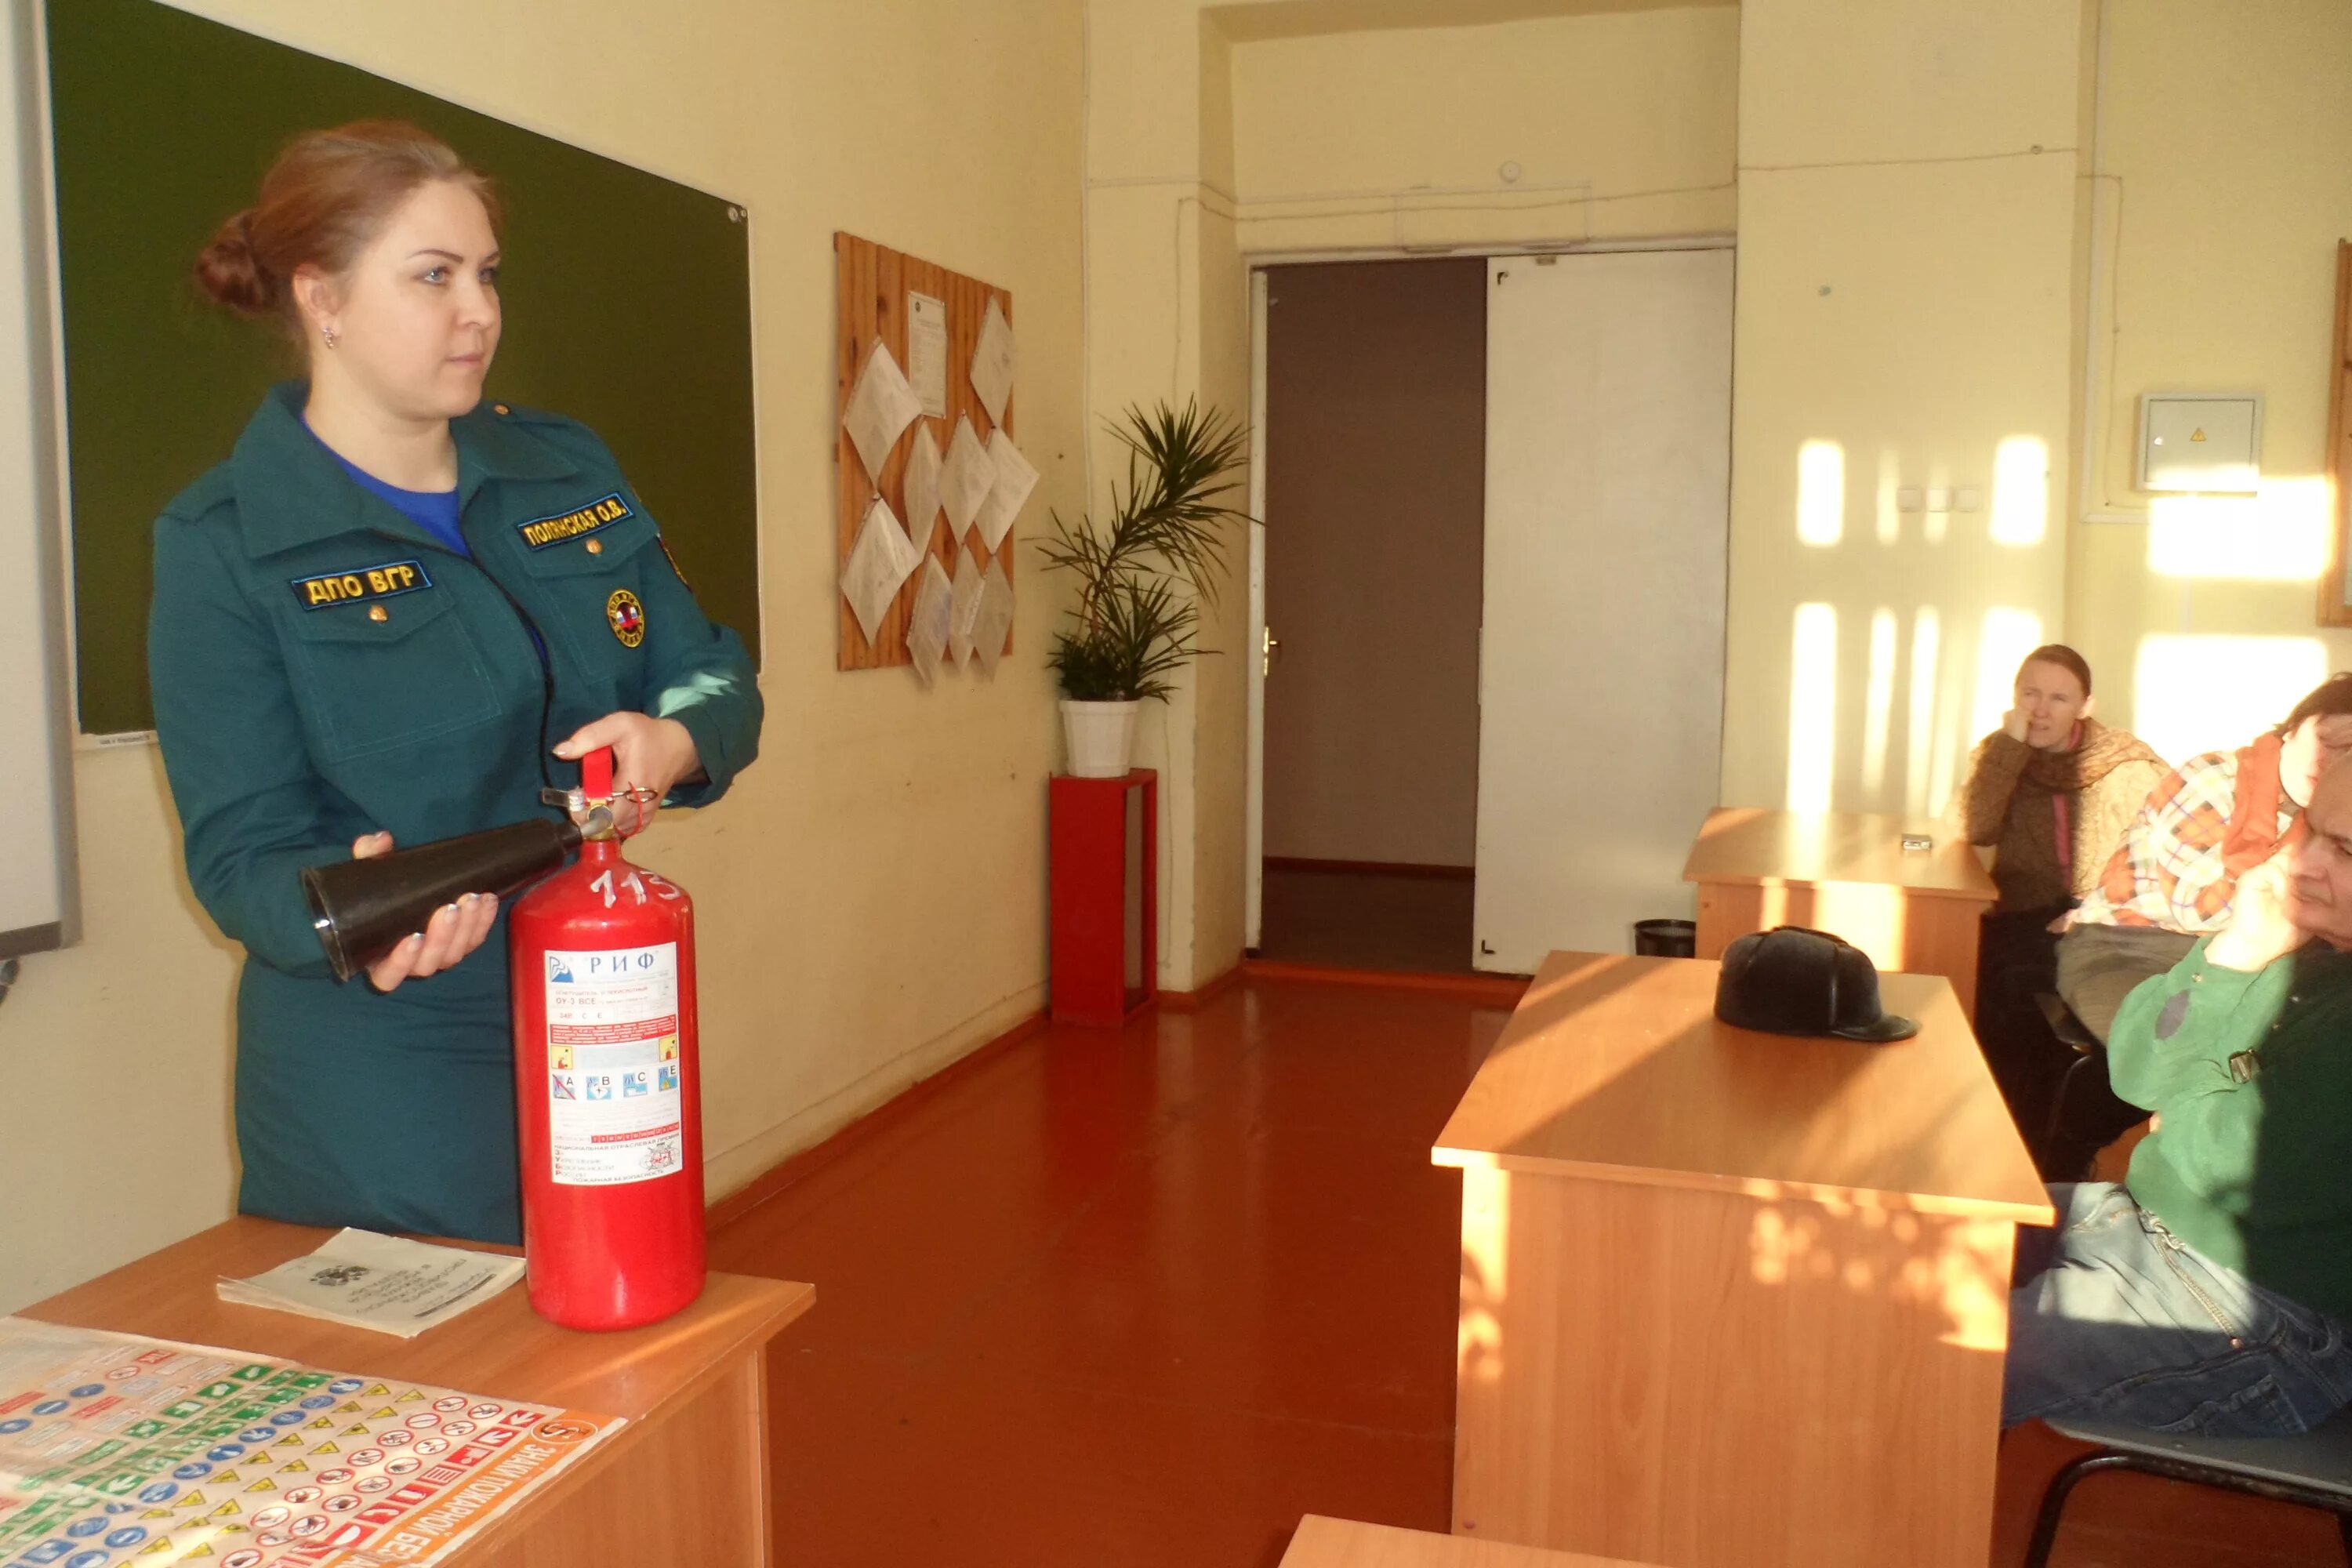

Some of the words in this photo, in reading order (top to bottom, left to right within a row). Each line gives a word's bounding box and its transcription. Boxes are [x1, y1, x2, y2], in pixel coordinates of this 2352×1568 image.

[524, 510, 600, 546] ПОЛЯНСКАЯ
[306, 575, 363, 604] ДПО
[368, 564, 415, 593] ВГР
[590, 869, 681, 909] 113
[590, 952, 655, 974] РИФ
[566, 1076, 574, 1086] A
[601, 1076, 610, 1086] B
[637, 1072, 646, 1082] C
[670, 1065, 677, 1075] E
[489, 1444, 556, 1479] ЗНАКИ
[408, 1475, 514, 1537] ПОЖАРНОЙ
